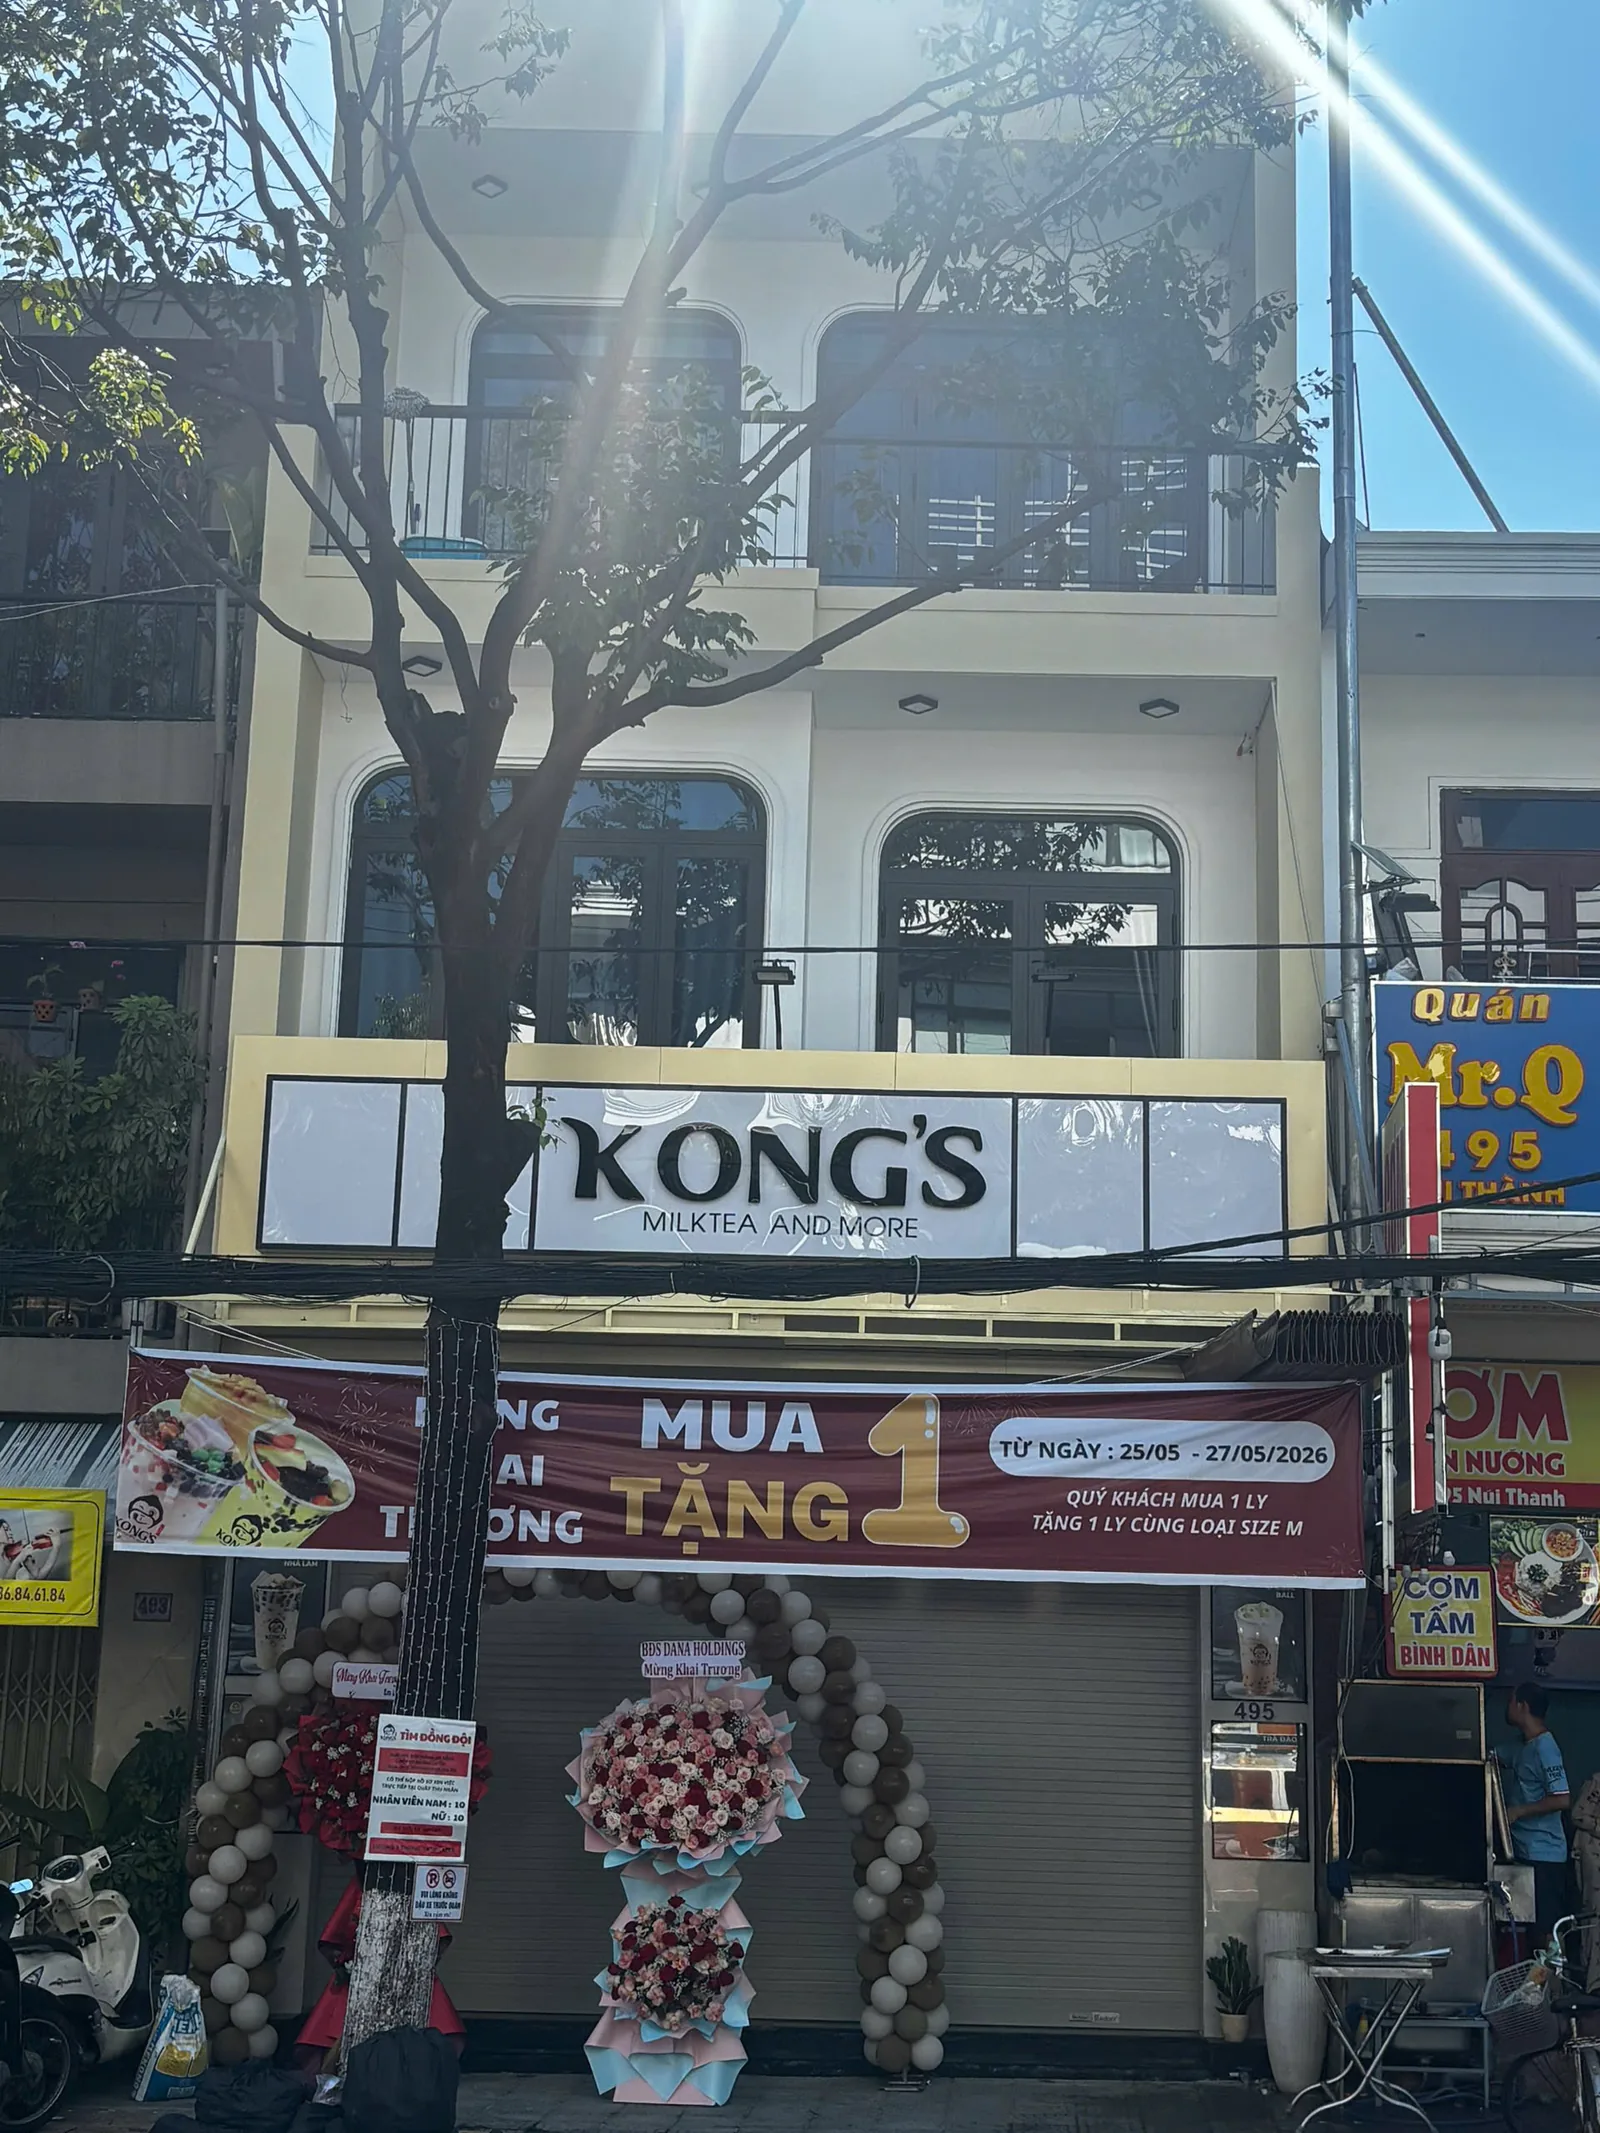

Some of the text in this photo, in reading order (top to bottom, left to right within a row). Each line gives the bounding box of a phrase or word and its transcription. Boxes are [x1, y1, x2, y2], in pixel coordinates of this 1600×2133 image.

[1413, 988, 1550, 1024] Quán
[1387, 1042, 1584, 1126] Mr.Q
[560, 1114, 987, 1209] KONG'S
[643, 1210, 920, 1239] MILKTEA AND MORE
[1446, 1369, 1569, 1441] ƠM
[641, 1398, 824, 1452] MUA
[999, 1436, 1033, 1458] TỪ
[1039, 1438, 1102, 1460] NGÀY
[1120, 1443, 1181, 1461] 25/05
[1206, 1445, 1328, 1464] 27/05/2026
[862, 1391, 970, 1548] 1
[610, 1462, 850, 1554] TẶNG
[1066, 1486, 1268, 1509] QUÝ KHÁCH MUA 1 LY
[1468, 1487, 1501, 1505] Núi
[1032, 1511, 1304, 1538] TẶNG 1 LY CÙNG LOẠI SIZE M
[1404, 1575, 1480, 1600] CƠM
[1410, 1602, 1475, 1634] TẤM
[664, 1642, 691, 1656] DANA
[694, 1641, 744, 1656] HOLDINGS
[1401, 1641, 1491, 1667] BÌNH DÂN
[676, 1663, 698, 1676] Khai
[1234, 1702, 1275, 1720] 495
[400, 1728, 472, 1746] TÌM ĐỒNG ĐỘI
[372, 1794, 401, 1805] NHÂN
[402, 1795, 424, 1806] VIÊN
[425, 1799, 447, 1808] NAM
[454, 1801, 466, 1809] 10
[431, 1811, 447, 1821] NỮ
[453, 1814, 465, 1822] 10
